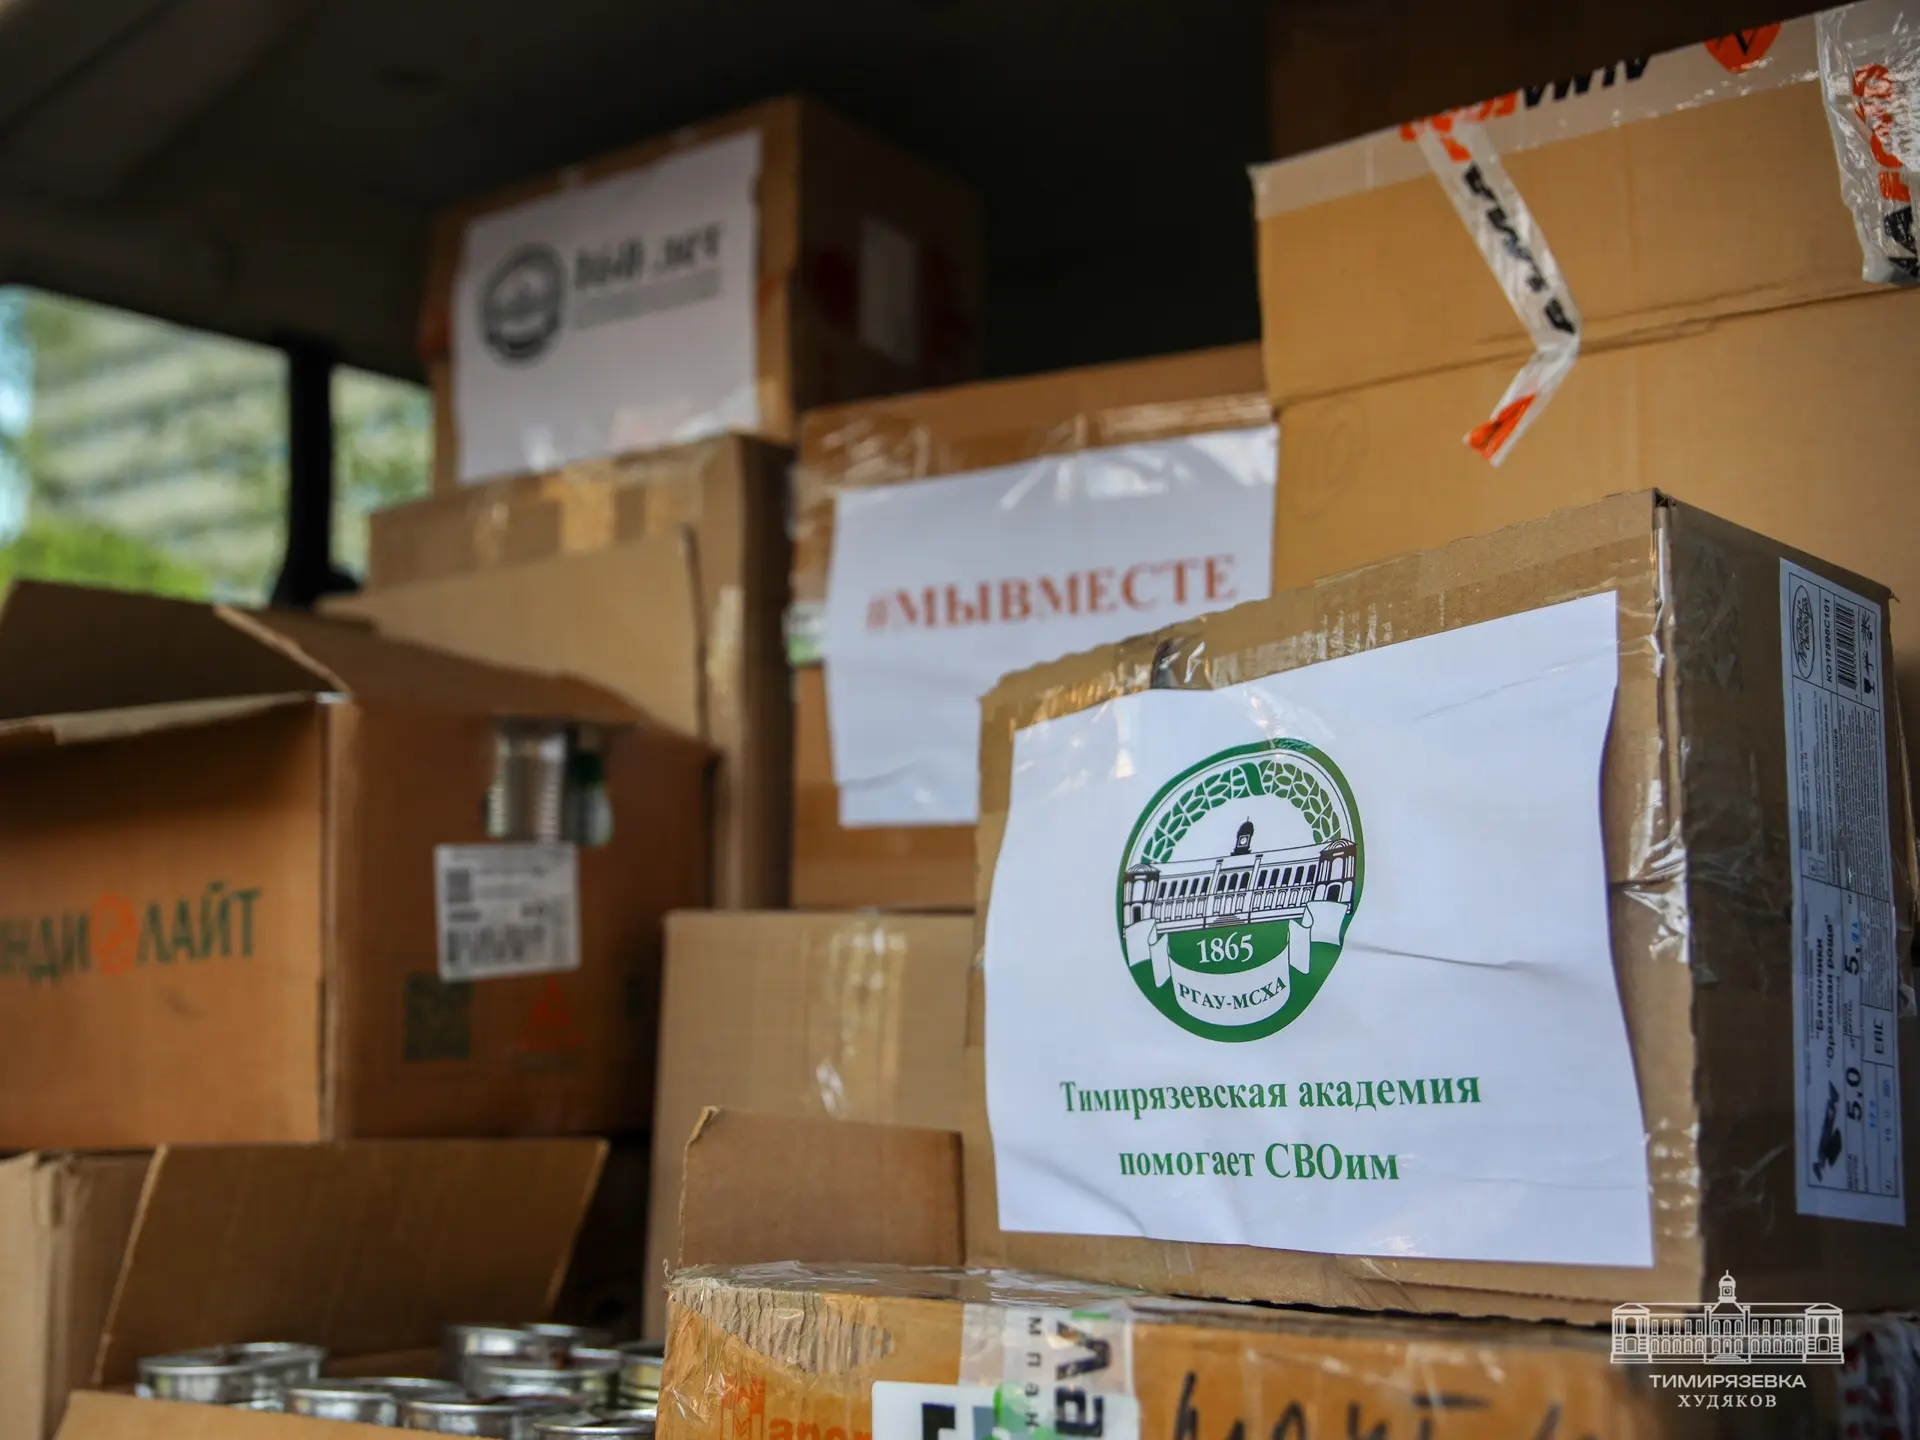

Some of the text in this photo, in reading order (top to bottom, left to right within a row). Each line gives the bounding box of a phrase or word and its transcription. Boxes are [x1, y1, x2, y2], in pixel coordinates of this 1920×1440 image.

[865, 553, 1238, 635] #МЫВМЕСТЕ
[1197, 931, 1254, 964] 1865
[1178, 976, 1287, 1010] РГАУ-МСХА
[1059, 1076, 1481, 1119] Тимирязевская академия
[1845, 1066, 1863, 1122] 5,0
[1118, 1142, 1400, 1181] помогает СВОим
